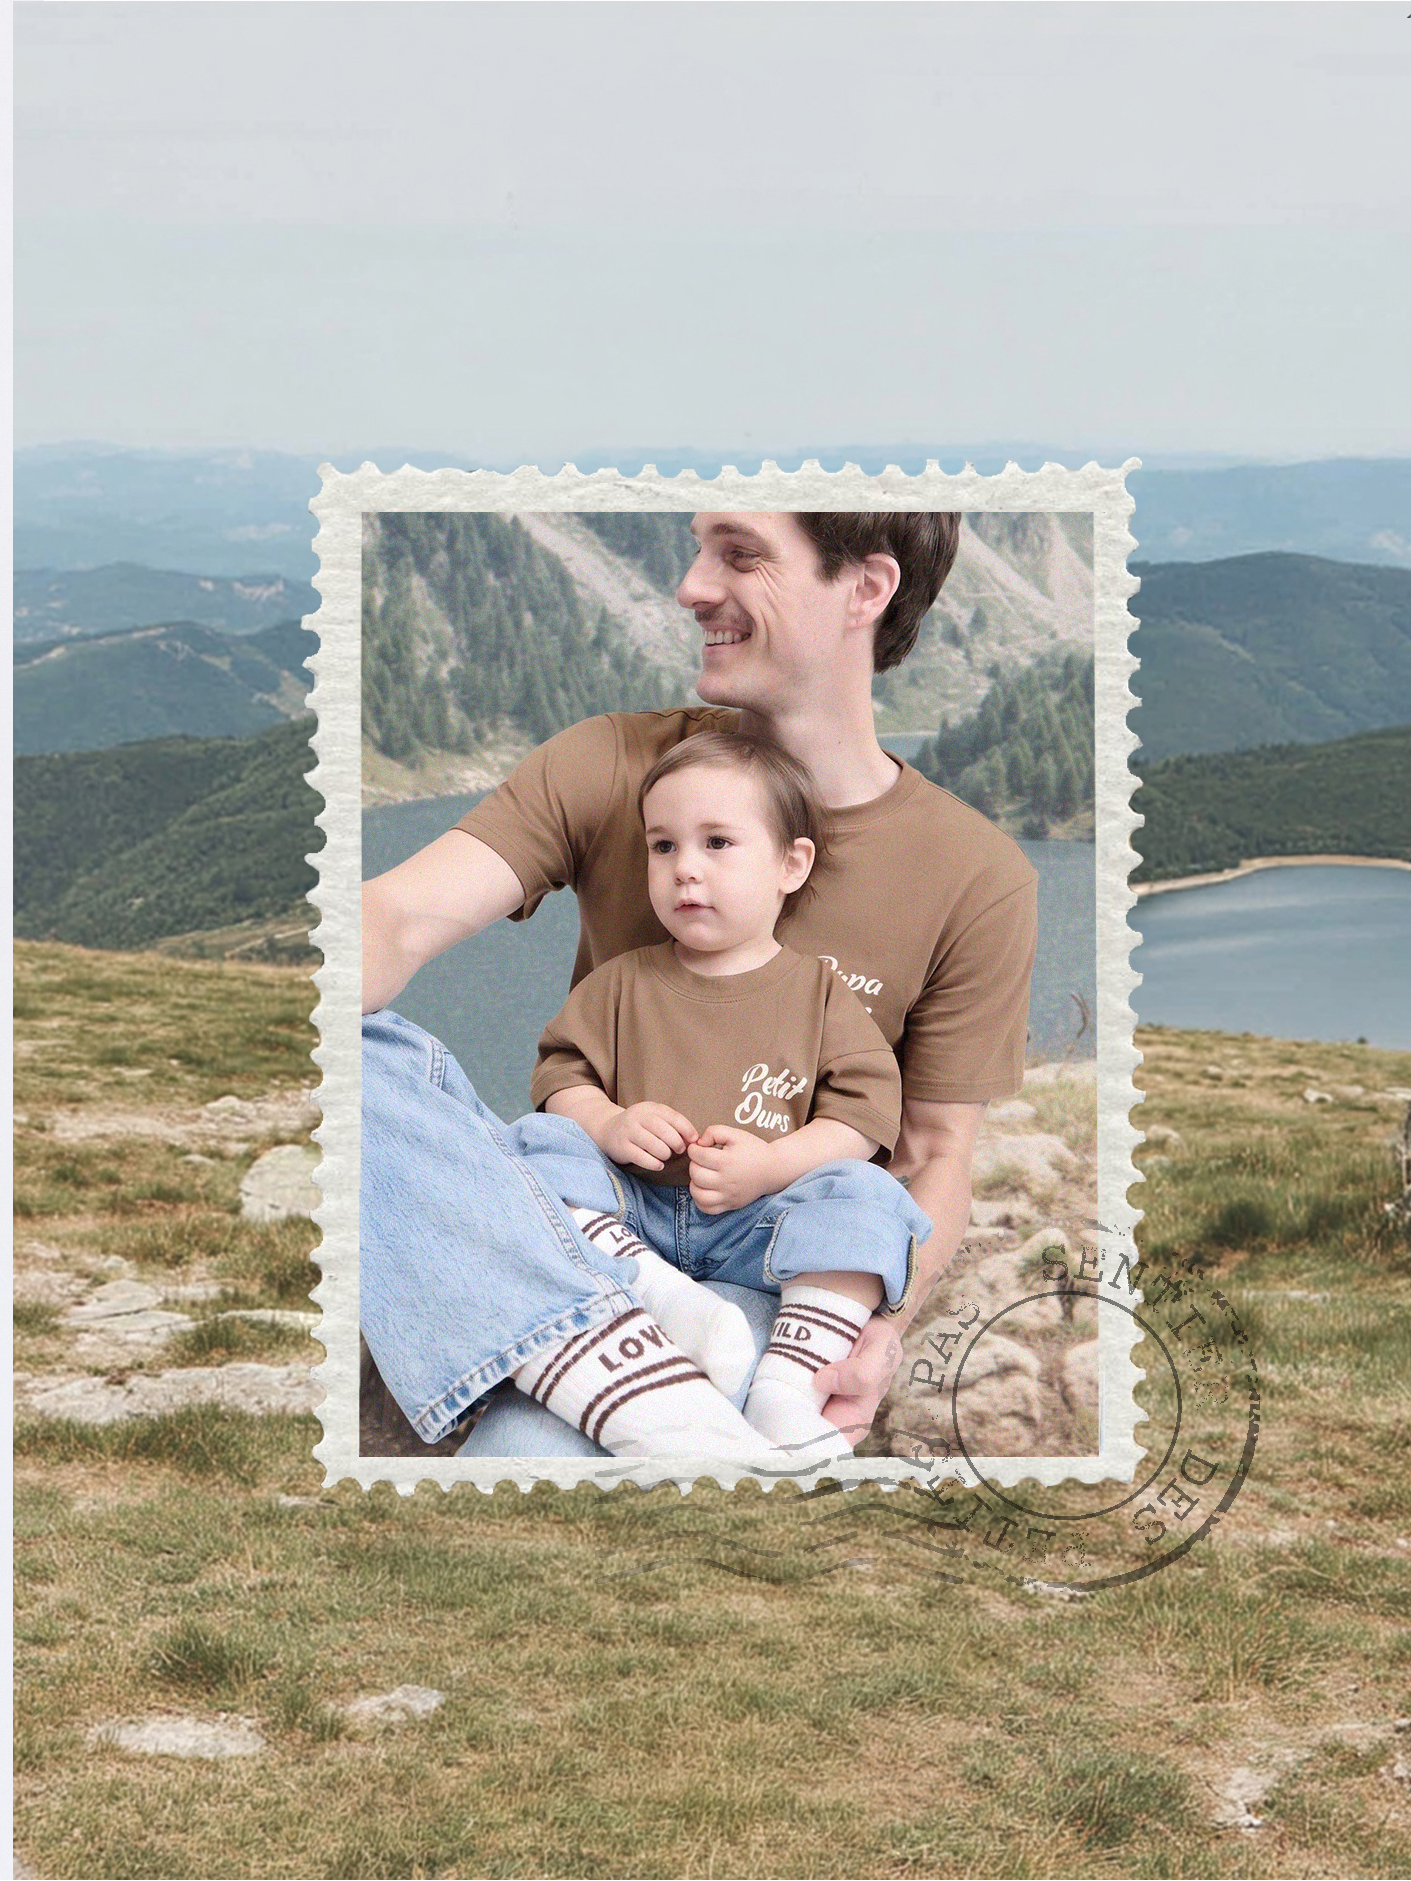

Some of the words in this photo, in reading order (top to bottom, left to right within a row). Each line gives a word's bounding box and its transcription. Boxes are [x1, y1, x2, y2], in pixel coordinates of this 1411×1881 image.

[817, 956, 884, 996] pa
[741, 1063, 808, 1100] Petit
[734, 1091, 790, 1133] Ours
[598, 1324, 675, 1373] LOV
[772, 1322, 811, 1341] ILD
